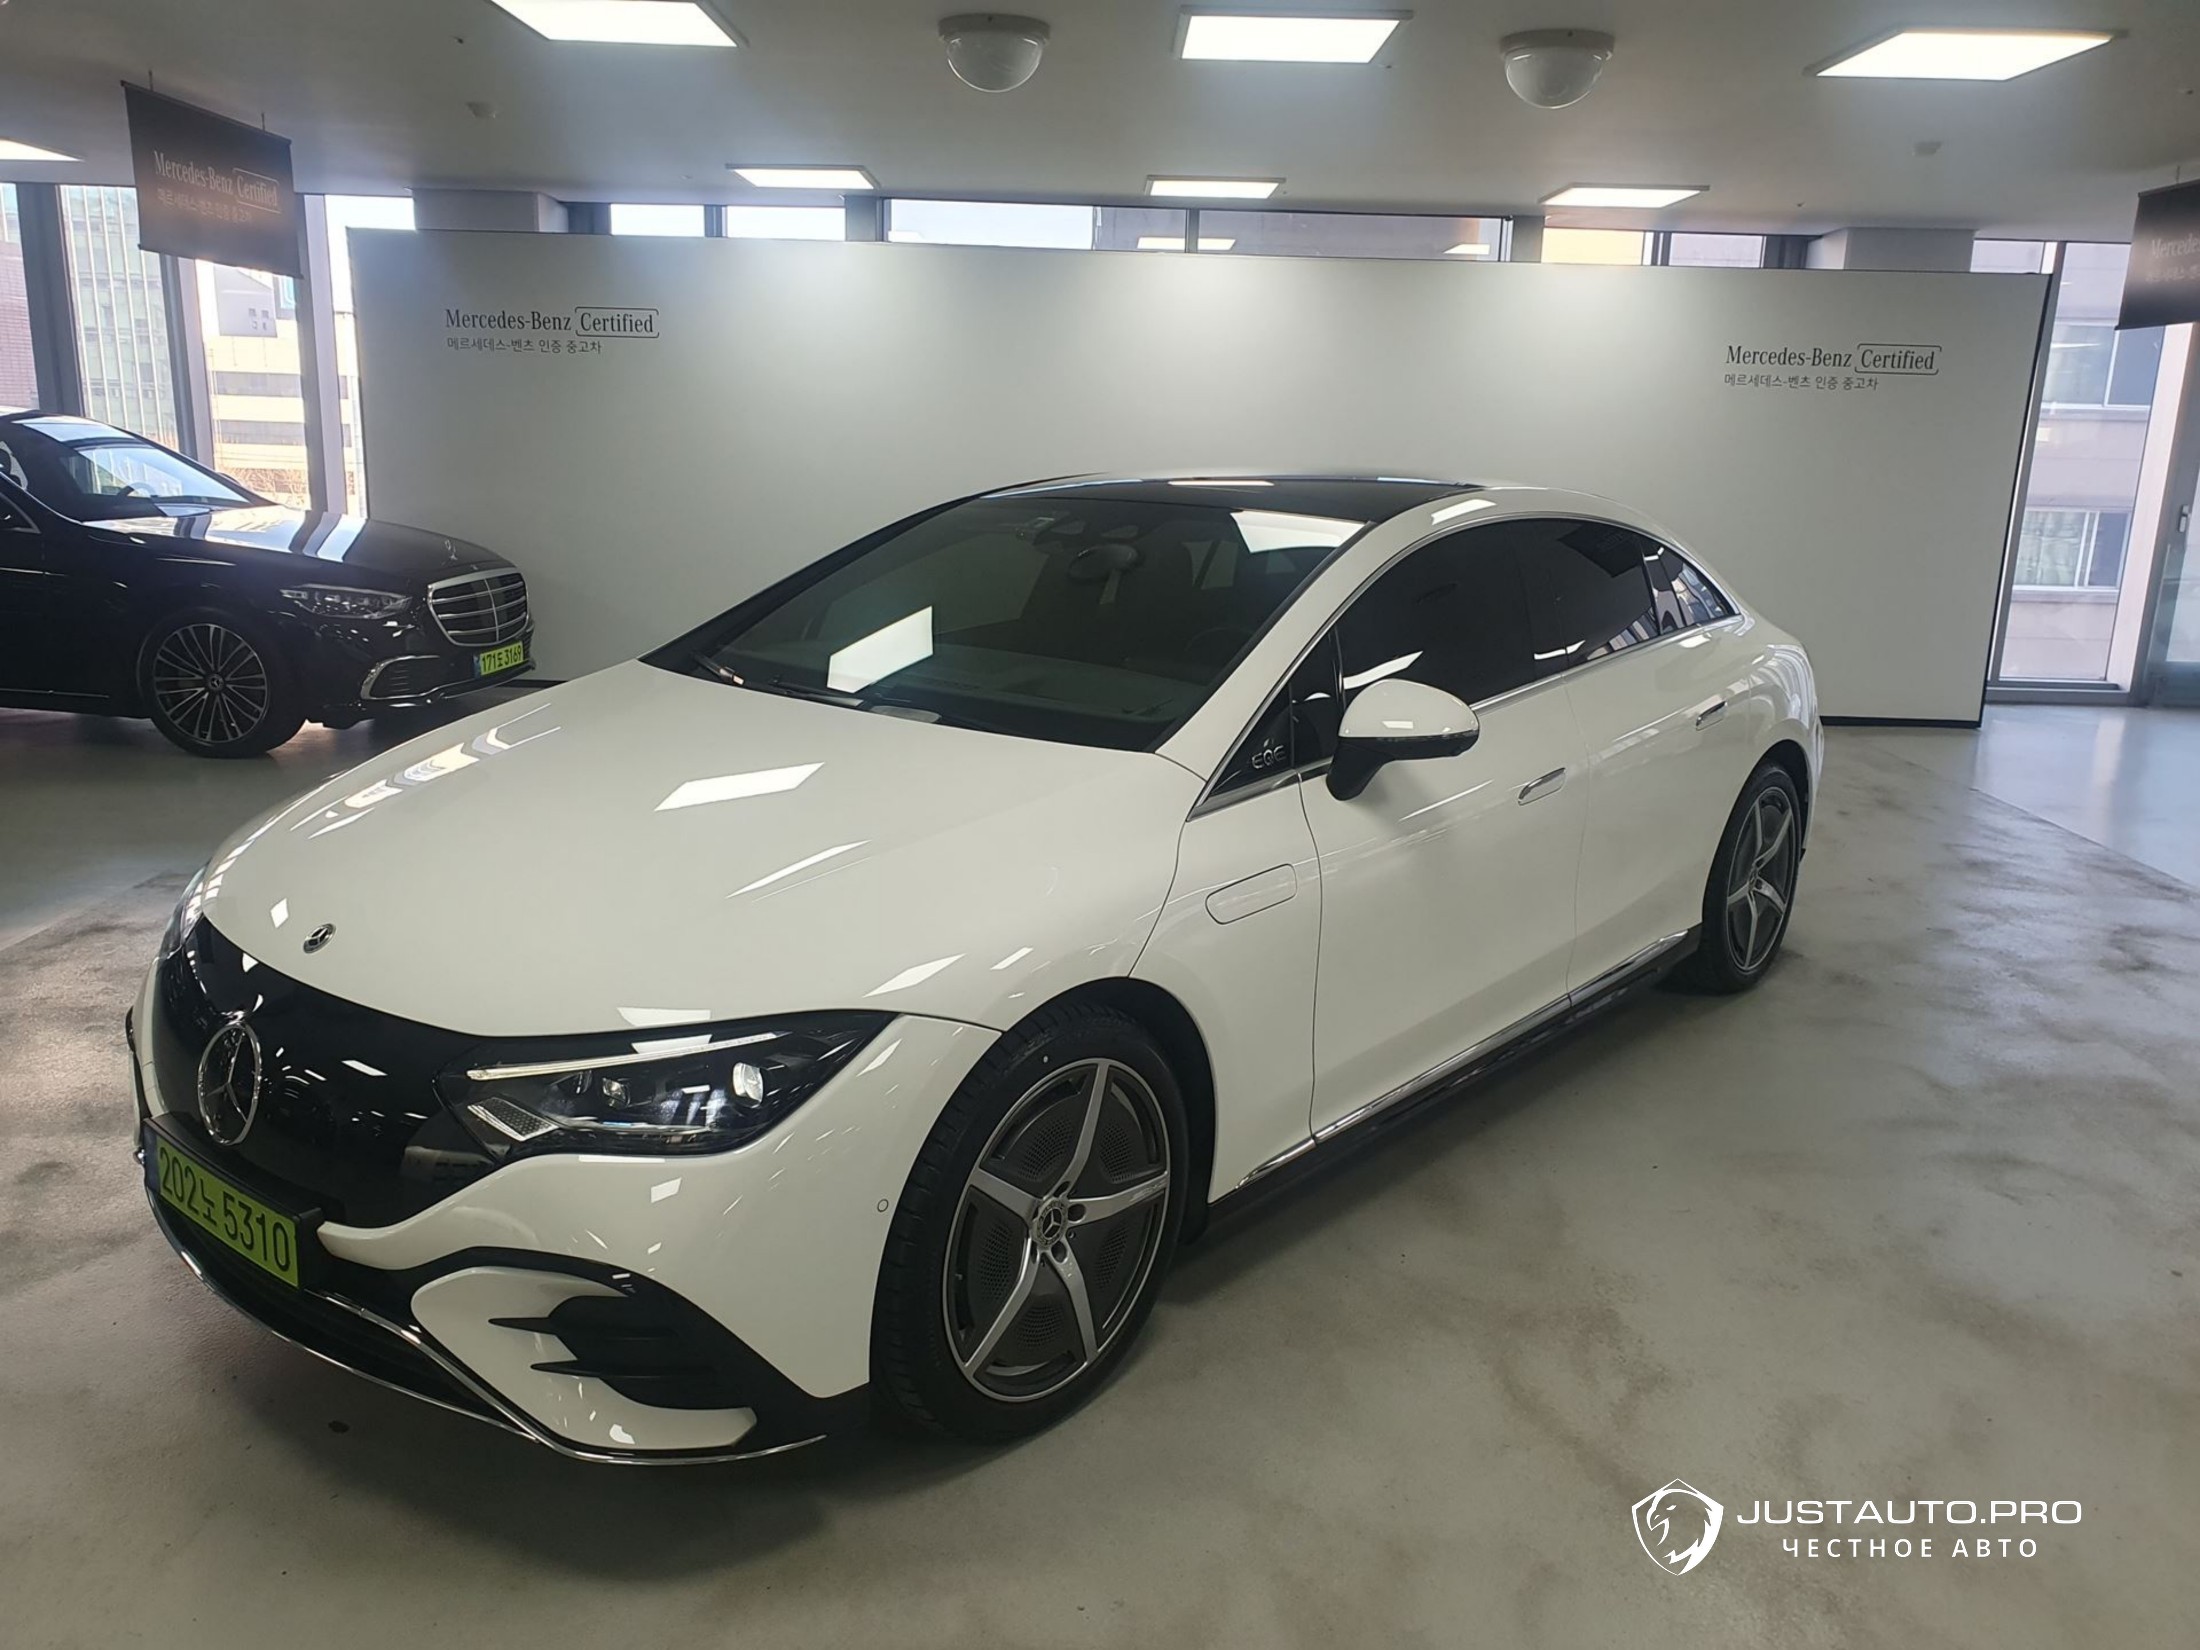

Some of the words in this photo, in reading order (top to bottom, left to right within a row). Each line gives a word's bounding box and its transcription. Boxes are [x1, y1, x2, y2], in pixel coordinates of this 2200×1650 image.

[154, 150, 234, 195] Mercedes-Benz
[236, 175, 278, 207] Certified
[446, 309, 571, 331] Mercedes-Benz
[580, 312, 654, 333] Certified
[447, 337, 536, 352] 메르세데스-벤츠
[539, 339, 562, 353] 인증
[566, 340, 602, 354] 중고차
[1726, 346, 1852, 367] Mercedes-Benz
[1861, 349, 1935, 370] Certified
[1724, 373, 1811, 388] 메르세데스-벤츠
[1816, 376, 1838, 390] 인증
[1842, 376, 1879, 391] 중고차
[1252, 745, 1287, 769] EQE
